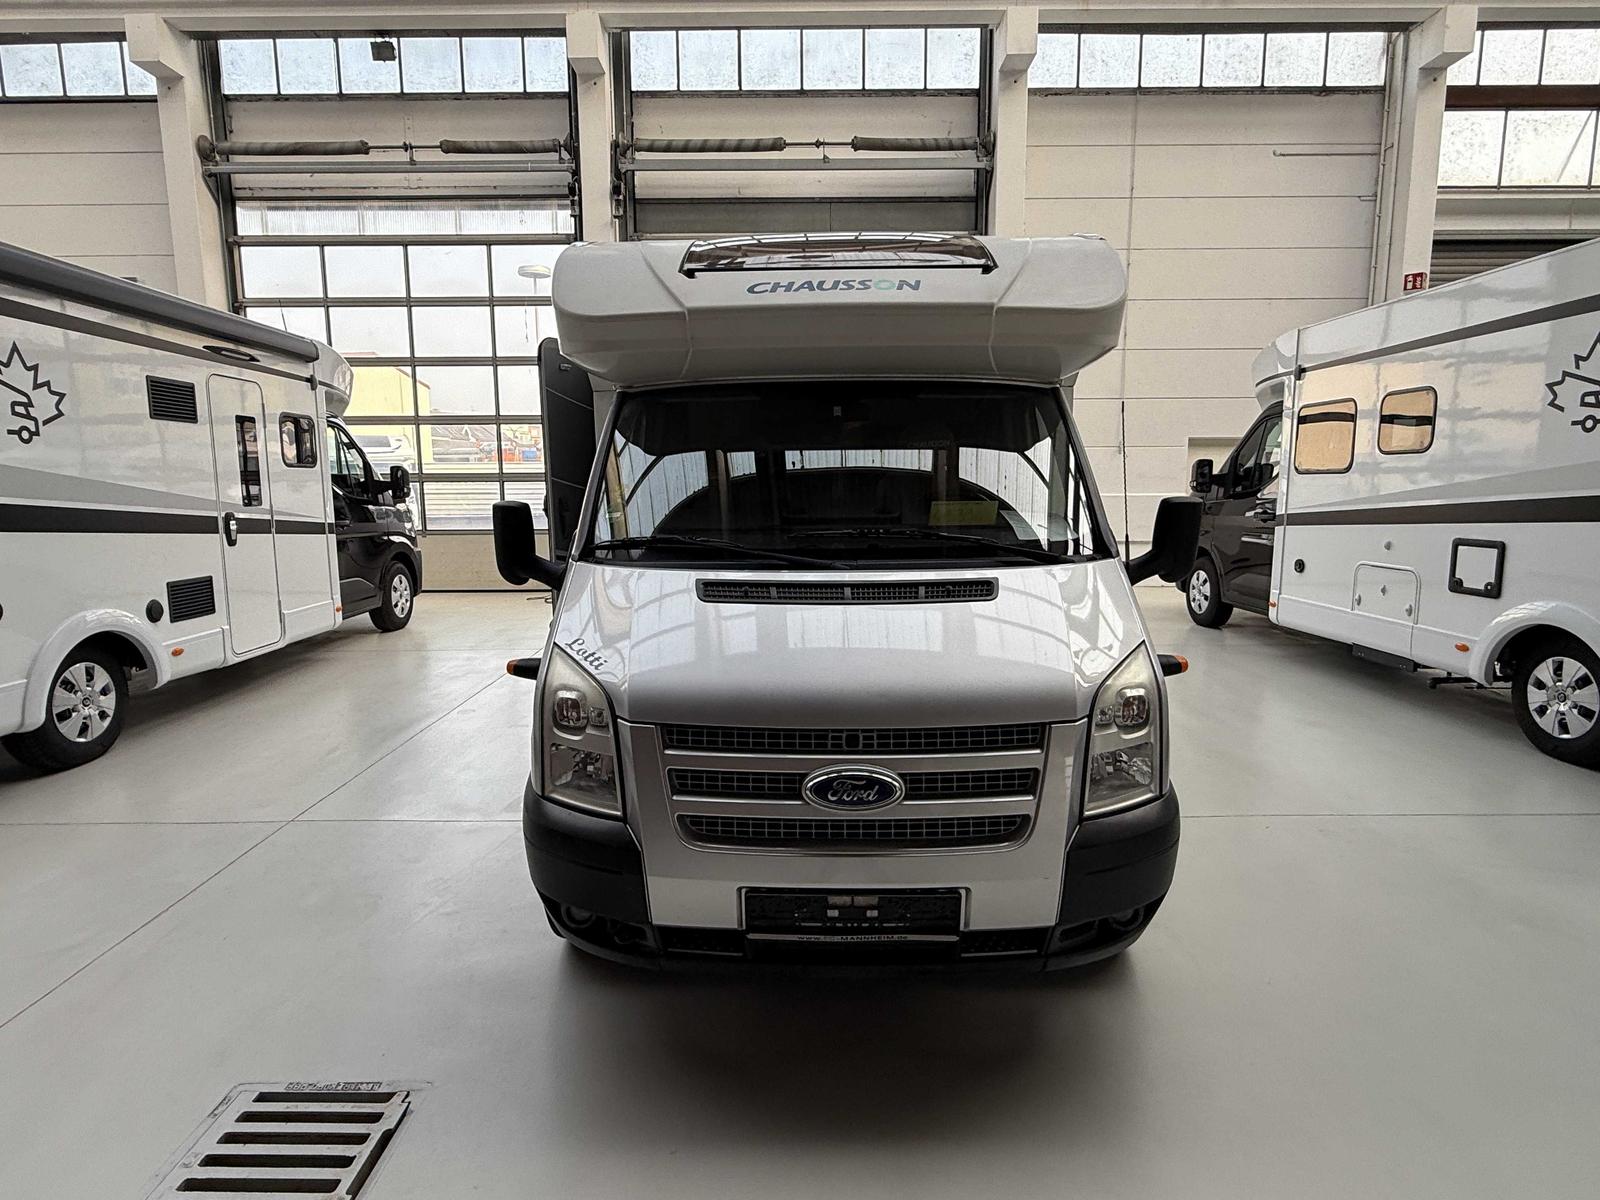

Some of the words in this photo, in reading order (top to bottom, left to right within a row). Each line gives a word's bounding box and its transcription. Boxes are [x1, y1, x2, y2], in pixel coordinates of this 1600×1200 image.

[746, 279, 921, 294] CHAUSSON
[565, 637, 608, 671] Lotti
[827, 779, 879, 801] Ford
